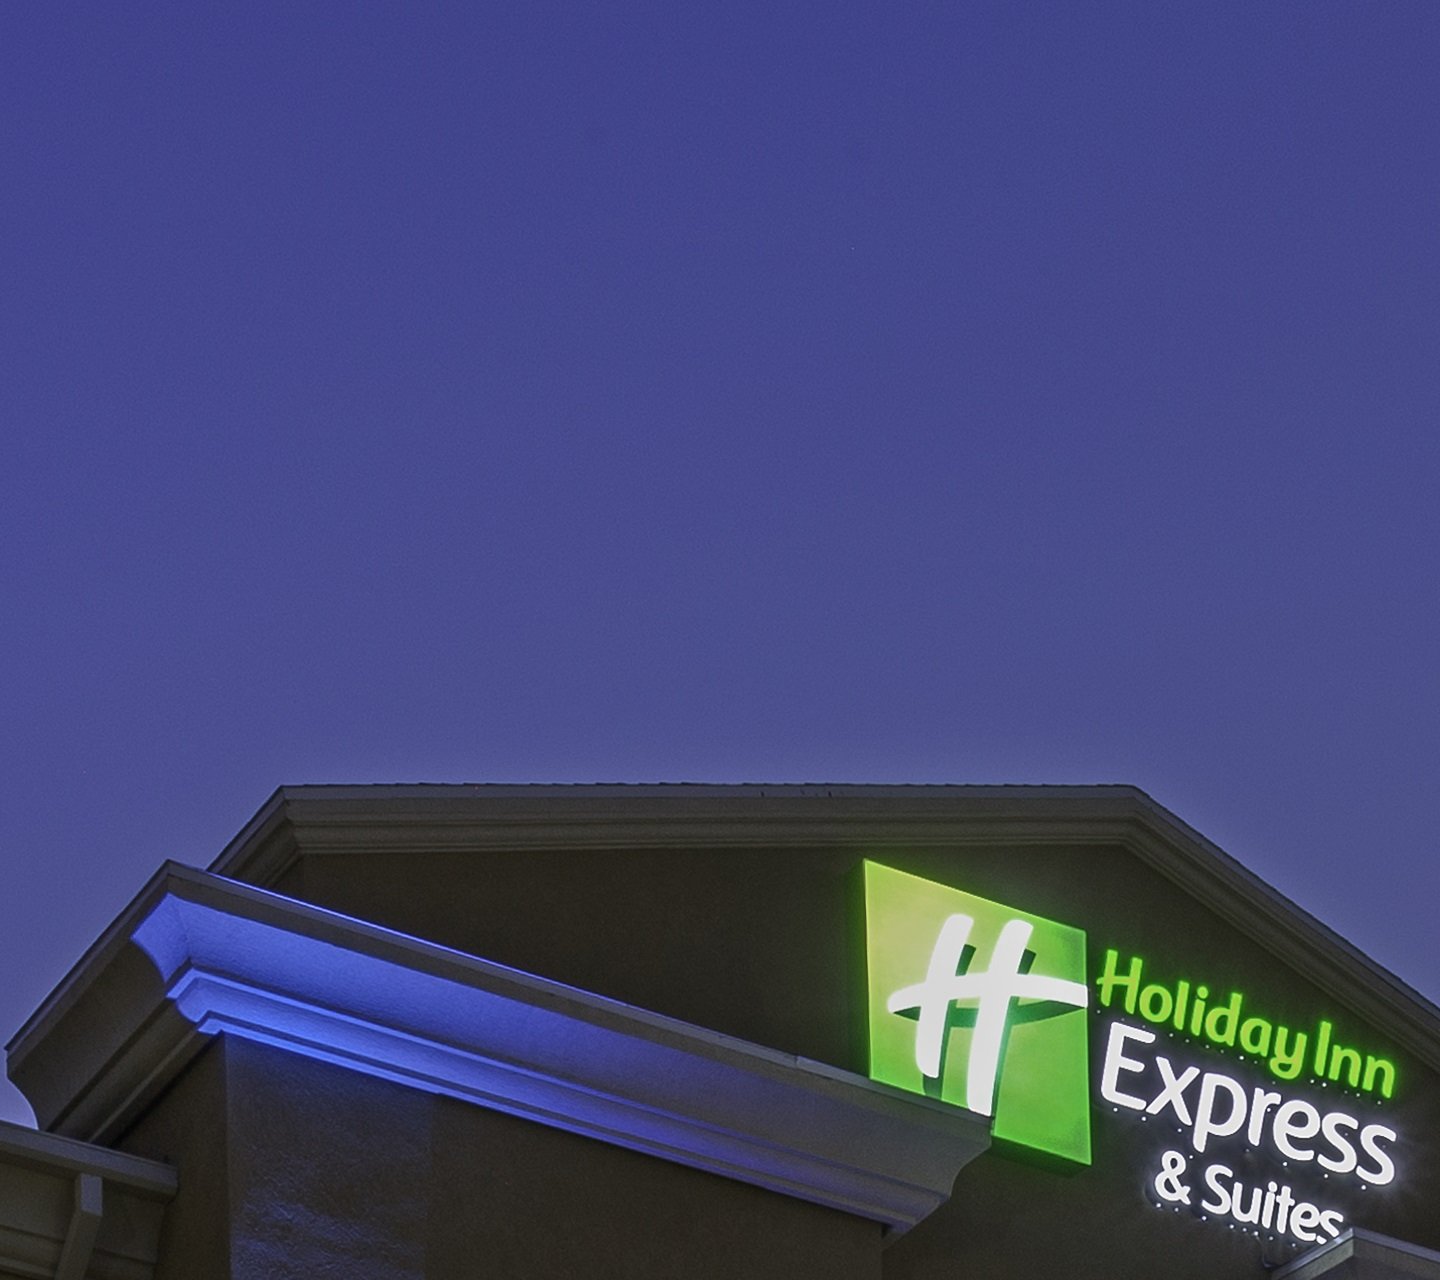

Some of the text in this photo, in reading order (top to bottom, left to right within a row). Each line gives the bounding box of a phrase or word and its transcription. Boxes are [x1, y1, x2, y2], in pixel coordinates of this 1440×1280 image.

[1094, 947, 1397, 1100] Holiday Inn
[1100, 1021, 1398, 1187] Express
[1153, 1150, 1345, 1244] & Suites
